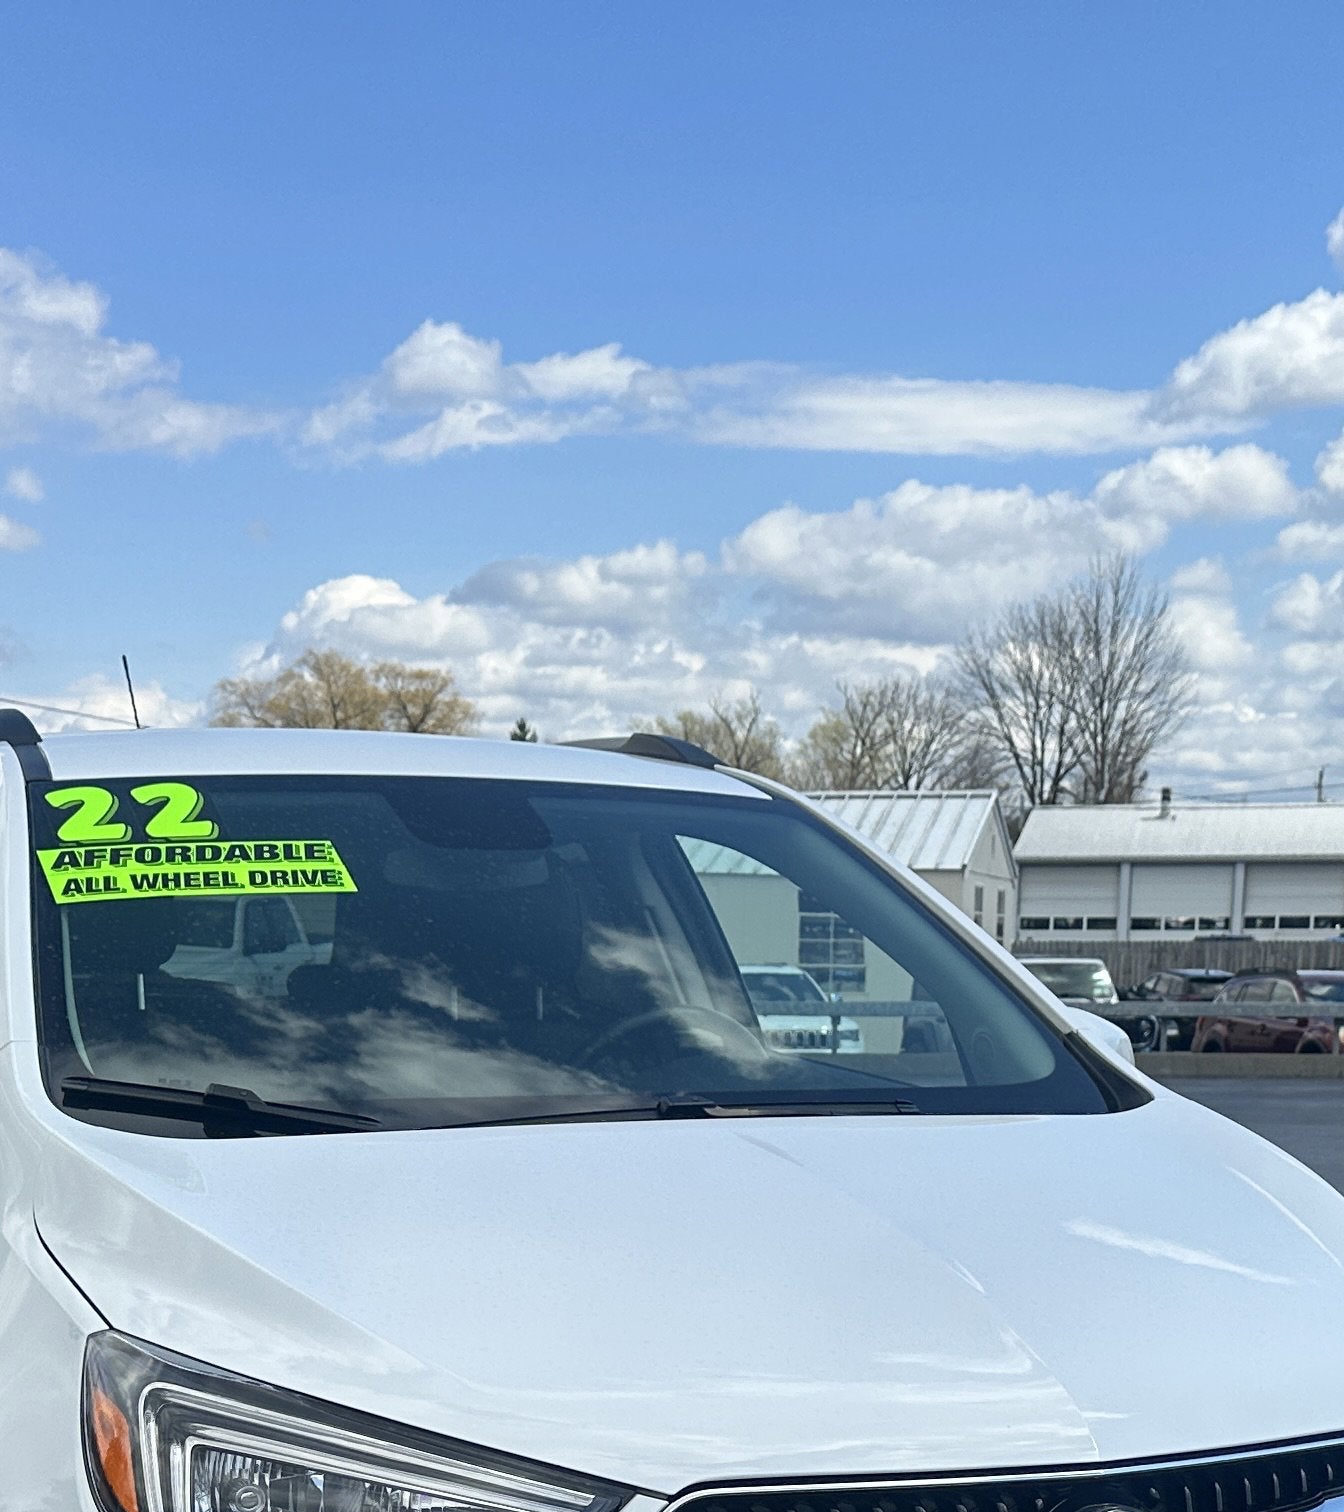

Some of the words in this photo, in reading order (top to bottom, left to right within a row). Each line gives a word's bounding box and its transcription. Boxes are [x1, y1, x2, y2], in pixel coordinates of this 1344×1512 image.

[44, 782, 216, 843] 22
[51, 842, 331, 871] AFFORDABLE
[61, 875, 123, 896] ALL
[129, 871, 240, 891] WHEEL
[248, 868, 340, 887] DRIVE
